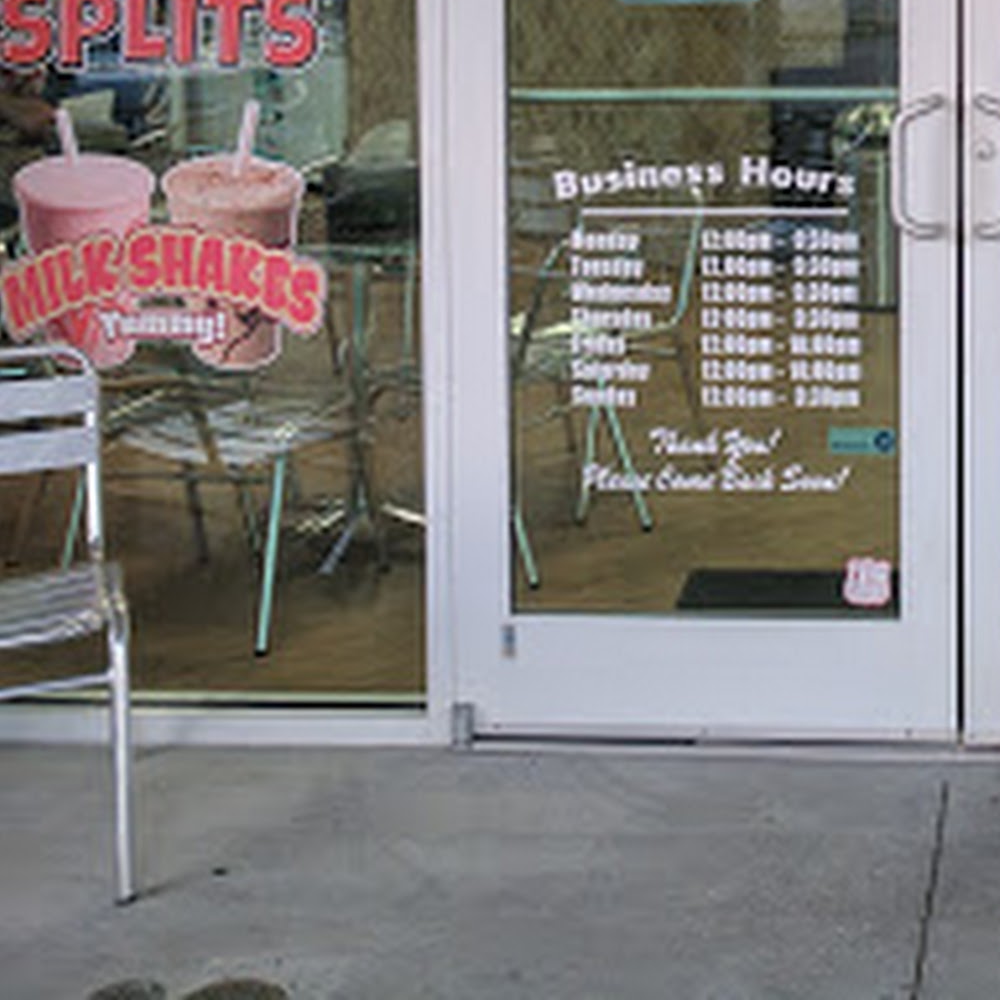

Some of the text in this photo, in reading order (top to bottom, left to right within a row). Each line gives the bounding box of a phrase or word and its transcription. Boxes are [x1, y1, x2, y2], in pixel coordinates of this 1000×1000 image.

[553, 155, 857, 200] Business Hours
[100, 311, 227, 344] Yummy!
